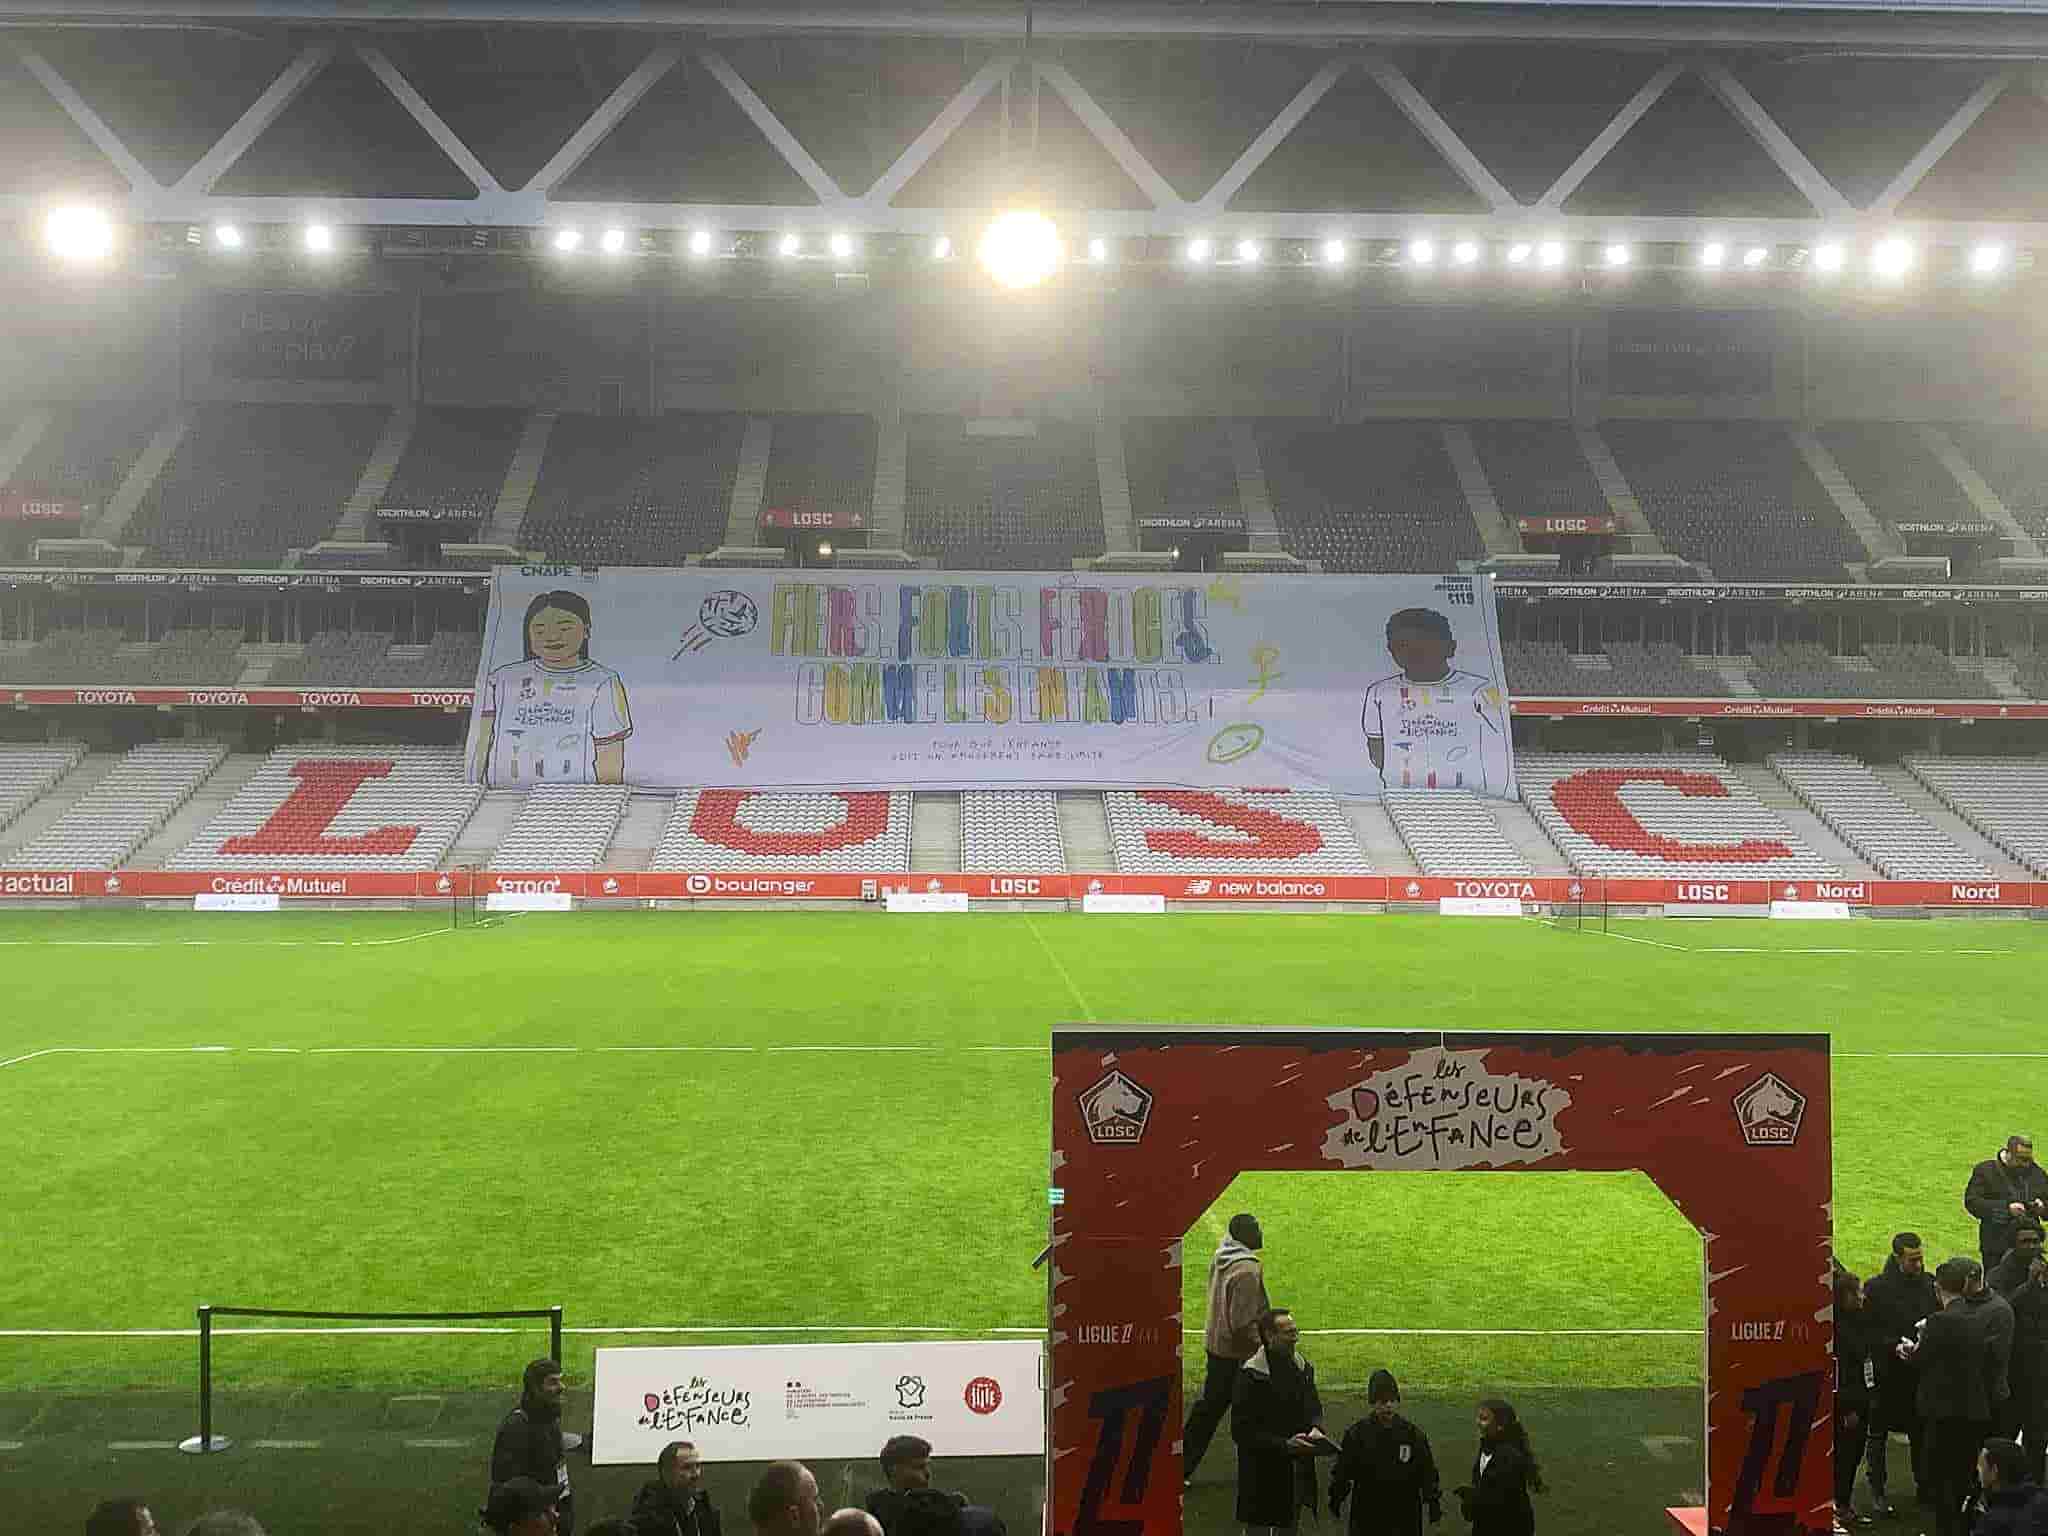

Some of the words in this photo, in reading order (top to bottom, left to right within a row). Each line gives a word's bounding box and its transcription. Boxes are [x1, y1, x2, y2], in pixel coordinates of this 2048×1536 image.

[793, 512, 833, 525] LOSC
[1546, 519, 1588, 532] LOSC
[114, 575, 166, 584] DECATHLON
[237, 576, 288, 585] DECATHLON
[301, 576, 342, 585] ARENA
[360, 577, 411, 586] DECATHLON
[424, 577, 464, 585] ARENA
[1547, 587, 1597, 597] DECATHLON
[1608, 588, 1648, 597] ARENA
[77, 691, 136, 704] TOYOTA
[189, 692, 249, 705] TOYOTA
[301, 692, 361, 705] TOYOTA
[413, 693, 473, 706] TOYOTA
[795, 663, 937, 726] COMME
[943, 663, 1013, 726] LES
[1620, 704, 1652, 714] Mutuel
[1763, 705, 1793, 714] Mutuel
[5, 876, 74, 895] actual
[211, 876, 265, 894] Crédit
[287, 878, 348, 894] Mutuel
[714, 878, 816, 895] boulanger
[990, 878, 1040, 895] LOSC
[1218, 882, 1253, 896] new
[1255, 879, 1324, 896] balance
[1455, 881, 1536, 898] TOYOTA
[1815, 884, 1865, 899] Nord
[1677, 884, 1729, 901] LOSC
[1951, 884, 2001, 900] Nord
[1096, 1125, 1136, 1138] LOSC
[1751, 1126, 1790, 1140] LOSC
[1078, 1325, 1120, 1345] LIGUE
[1732, 1320, 1773, 1342] LIGUE
